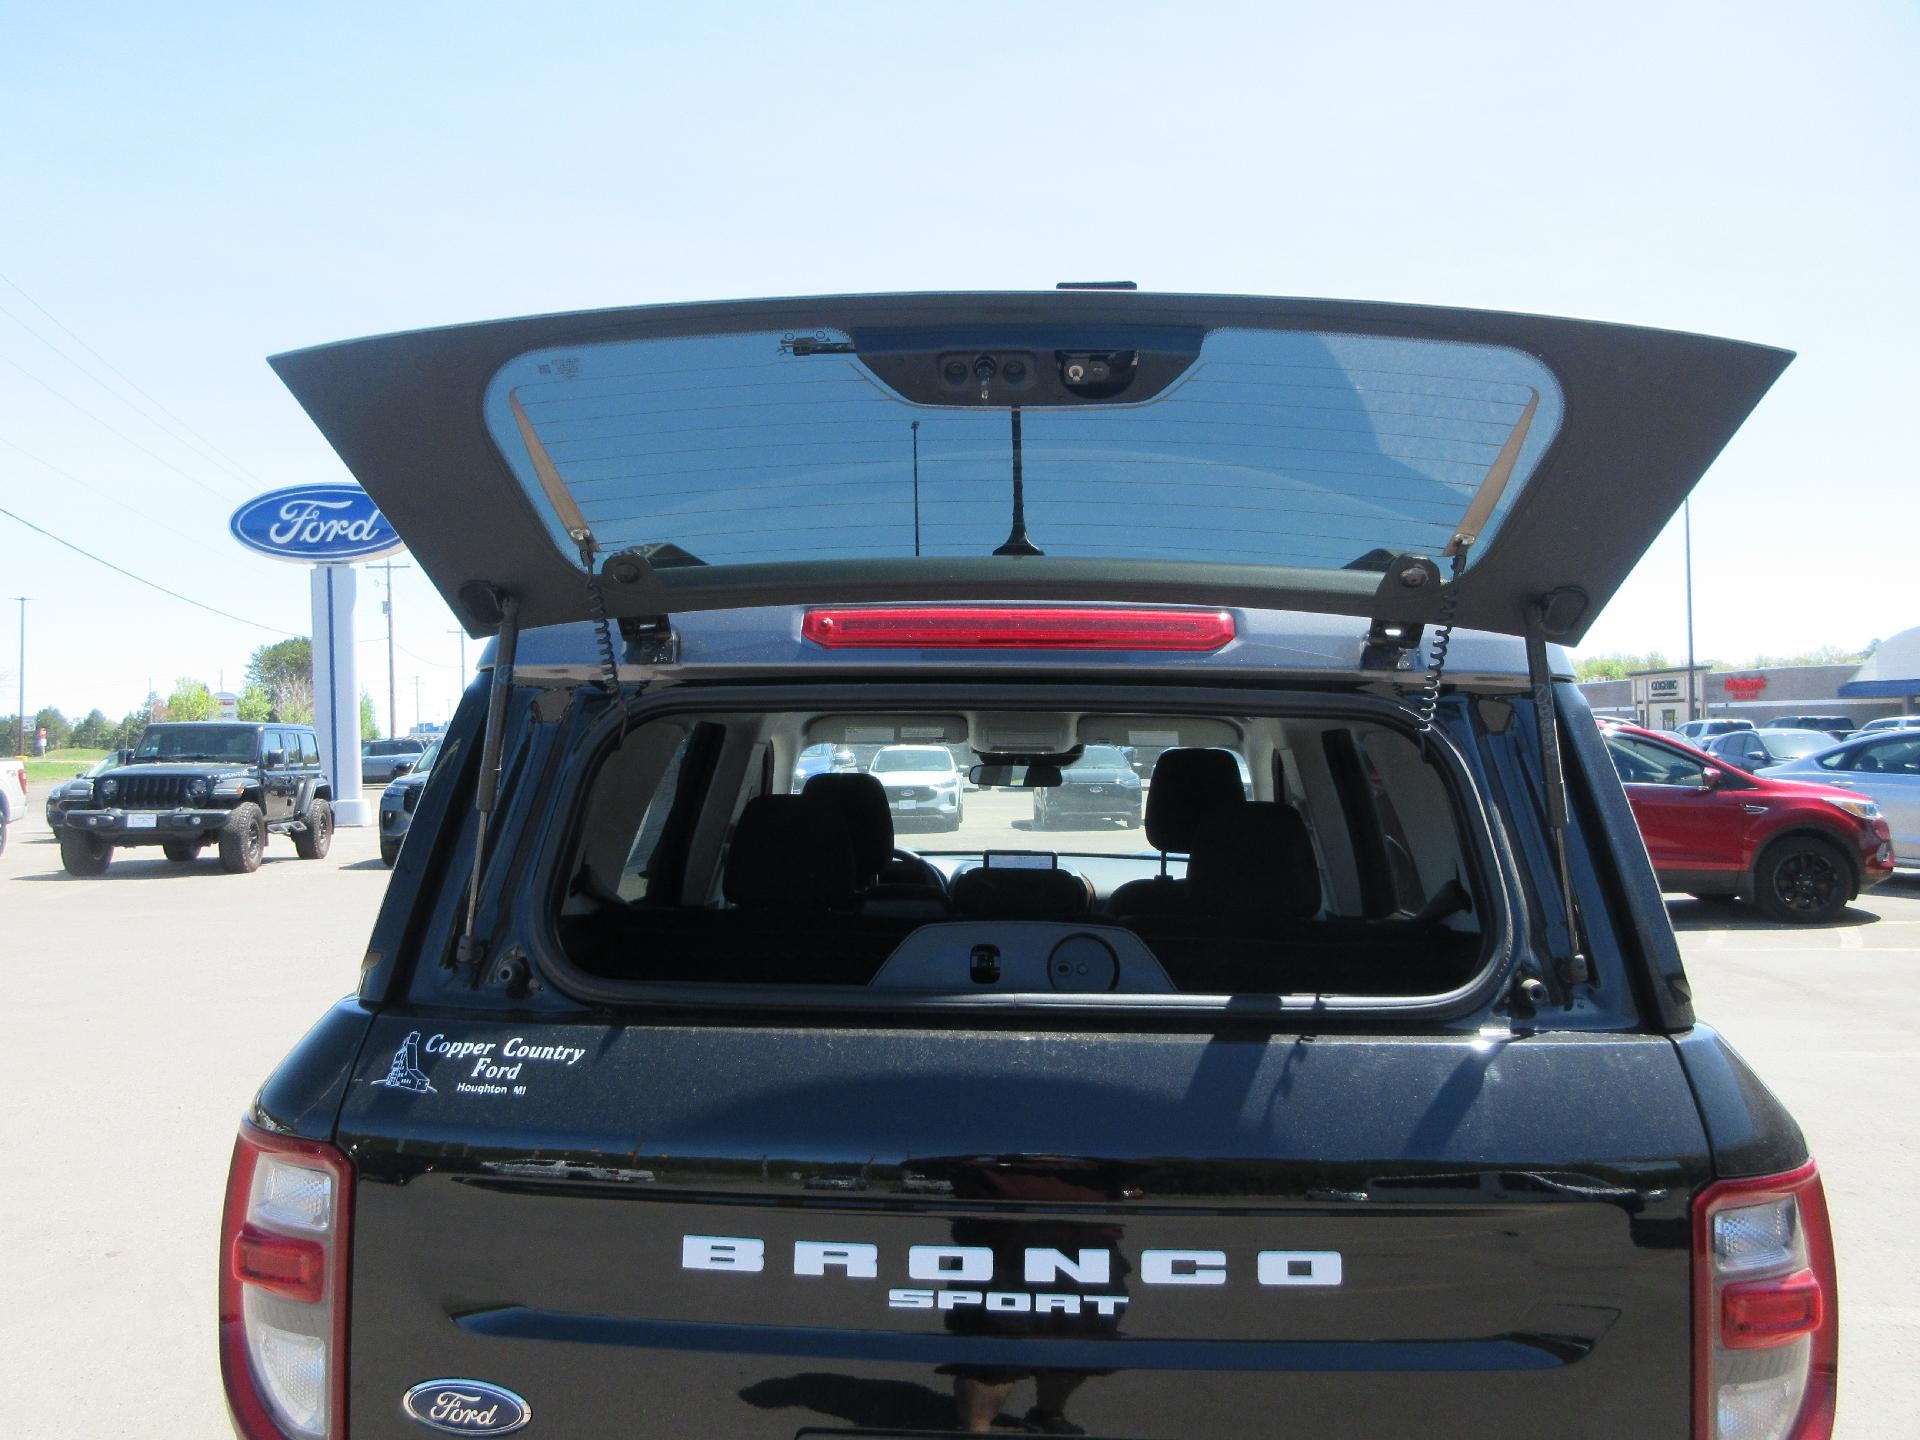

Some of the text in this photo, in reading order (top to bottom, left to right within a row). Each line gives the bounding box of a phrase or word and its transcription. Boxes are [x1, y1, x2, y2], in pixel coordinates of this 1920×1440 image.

[269, 500, 381, 544] Ford
[425, 1033, 586, 1065] Copper Country
[471, 1057, 523, 1080] Ford
[456, 1082, 527, 1096] Houghton MI
[682, 1234, 1343, 1287] BRONCO
[888, 1288, 1129, 1315] SPORT
[430, 1391, 499, 1425] Ford
